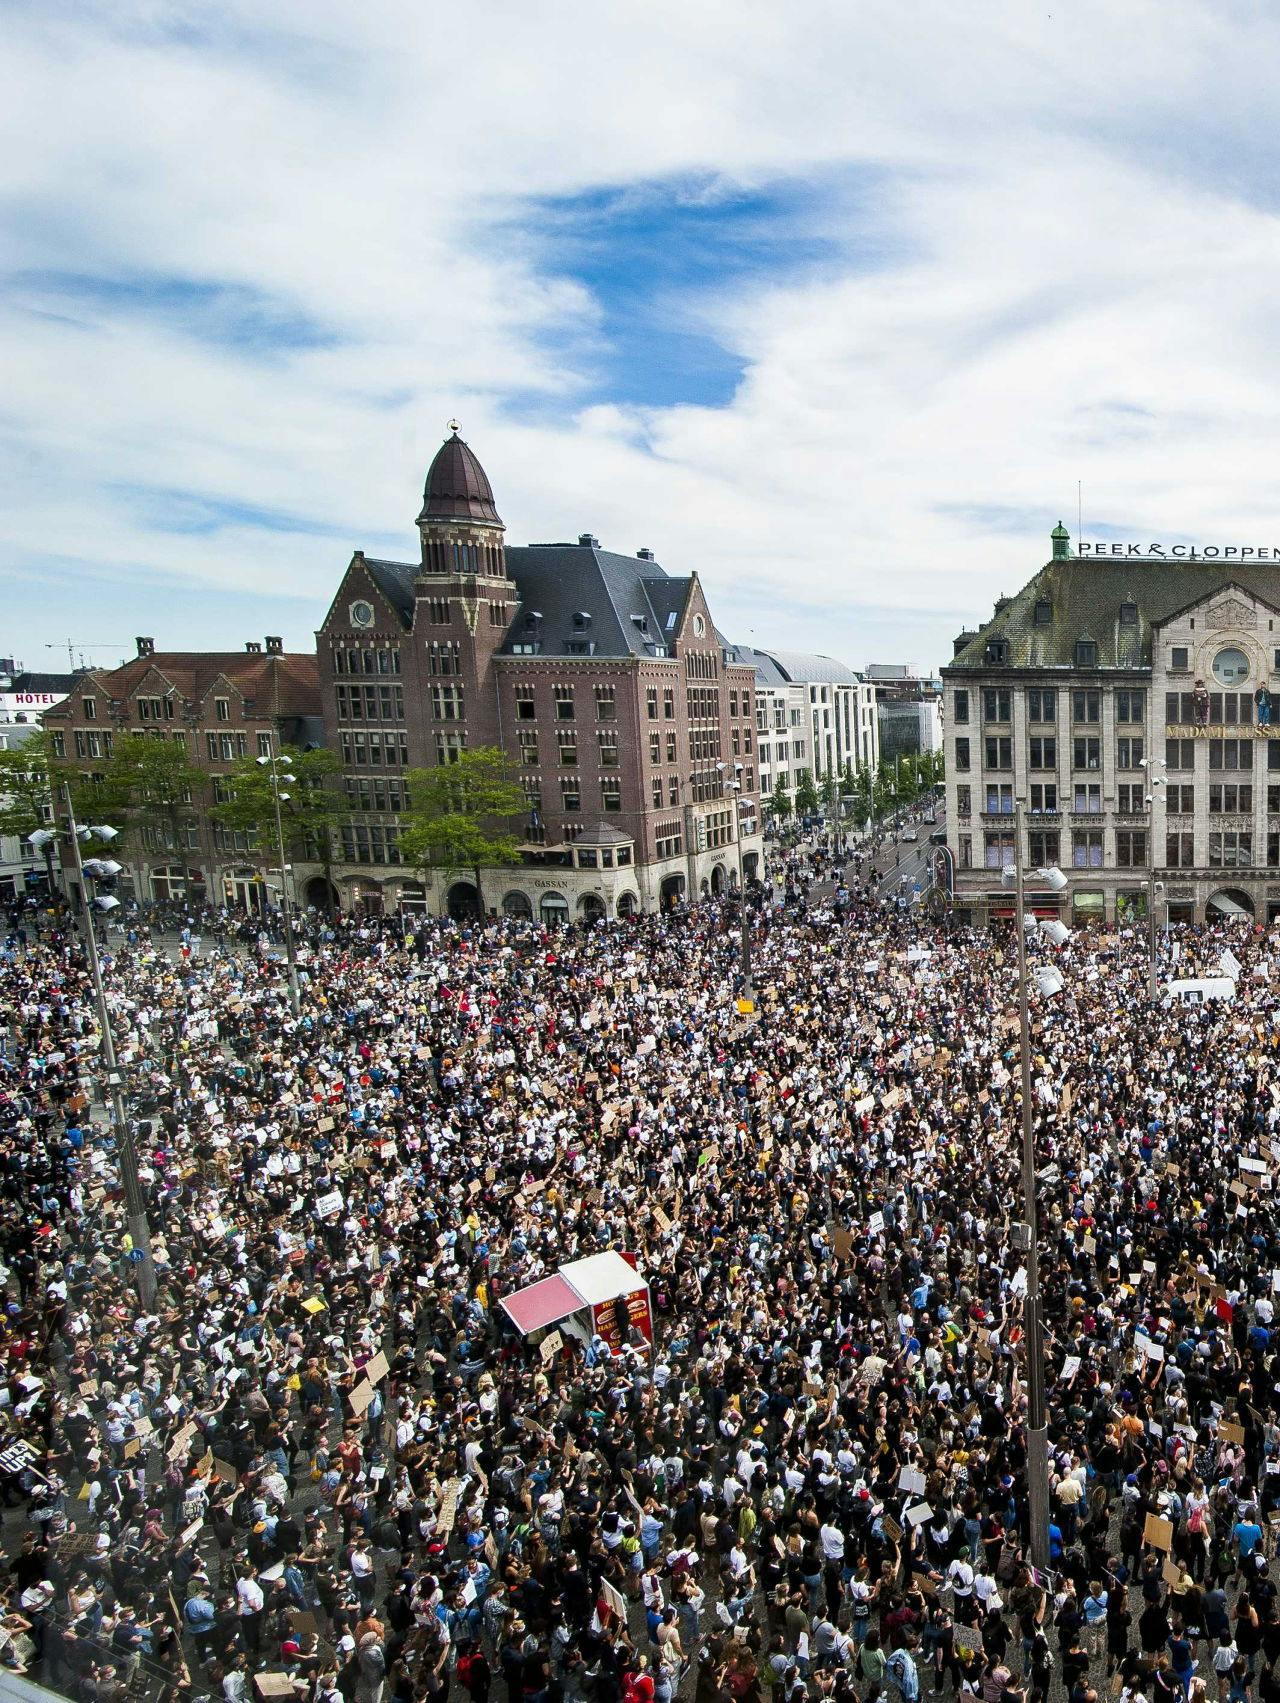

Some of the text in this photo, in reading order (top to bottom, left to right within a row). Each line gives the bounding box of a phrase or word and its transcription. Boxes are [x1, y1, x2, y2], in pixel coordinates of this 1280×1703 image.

[1078, 543, 1141, 555] PEEK
[1148, 543, 1166, 557] &
[16, 694, 57, 703] HOTEL
[534, 880, 568, 888] GASSAN
